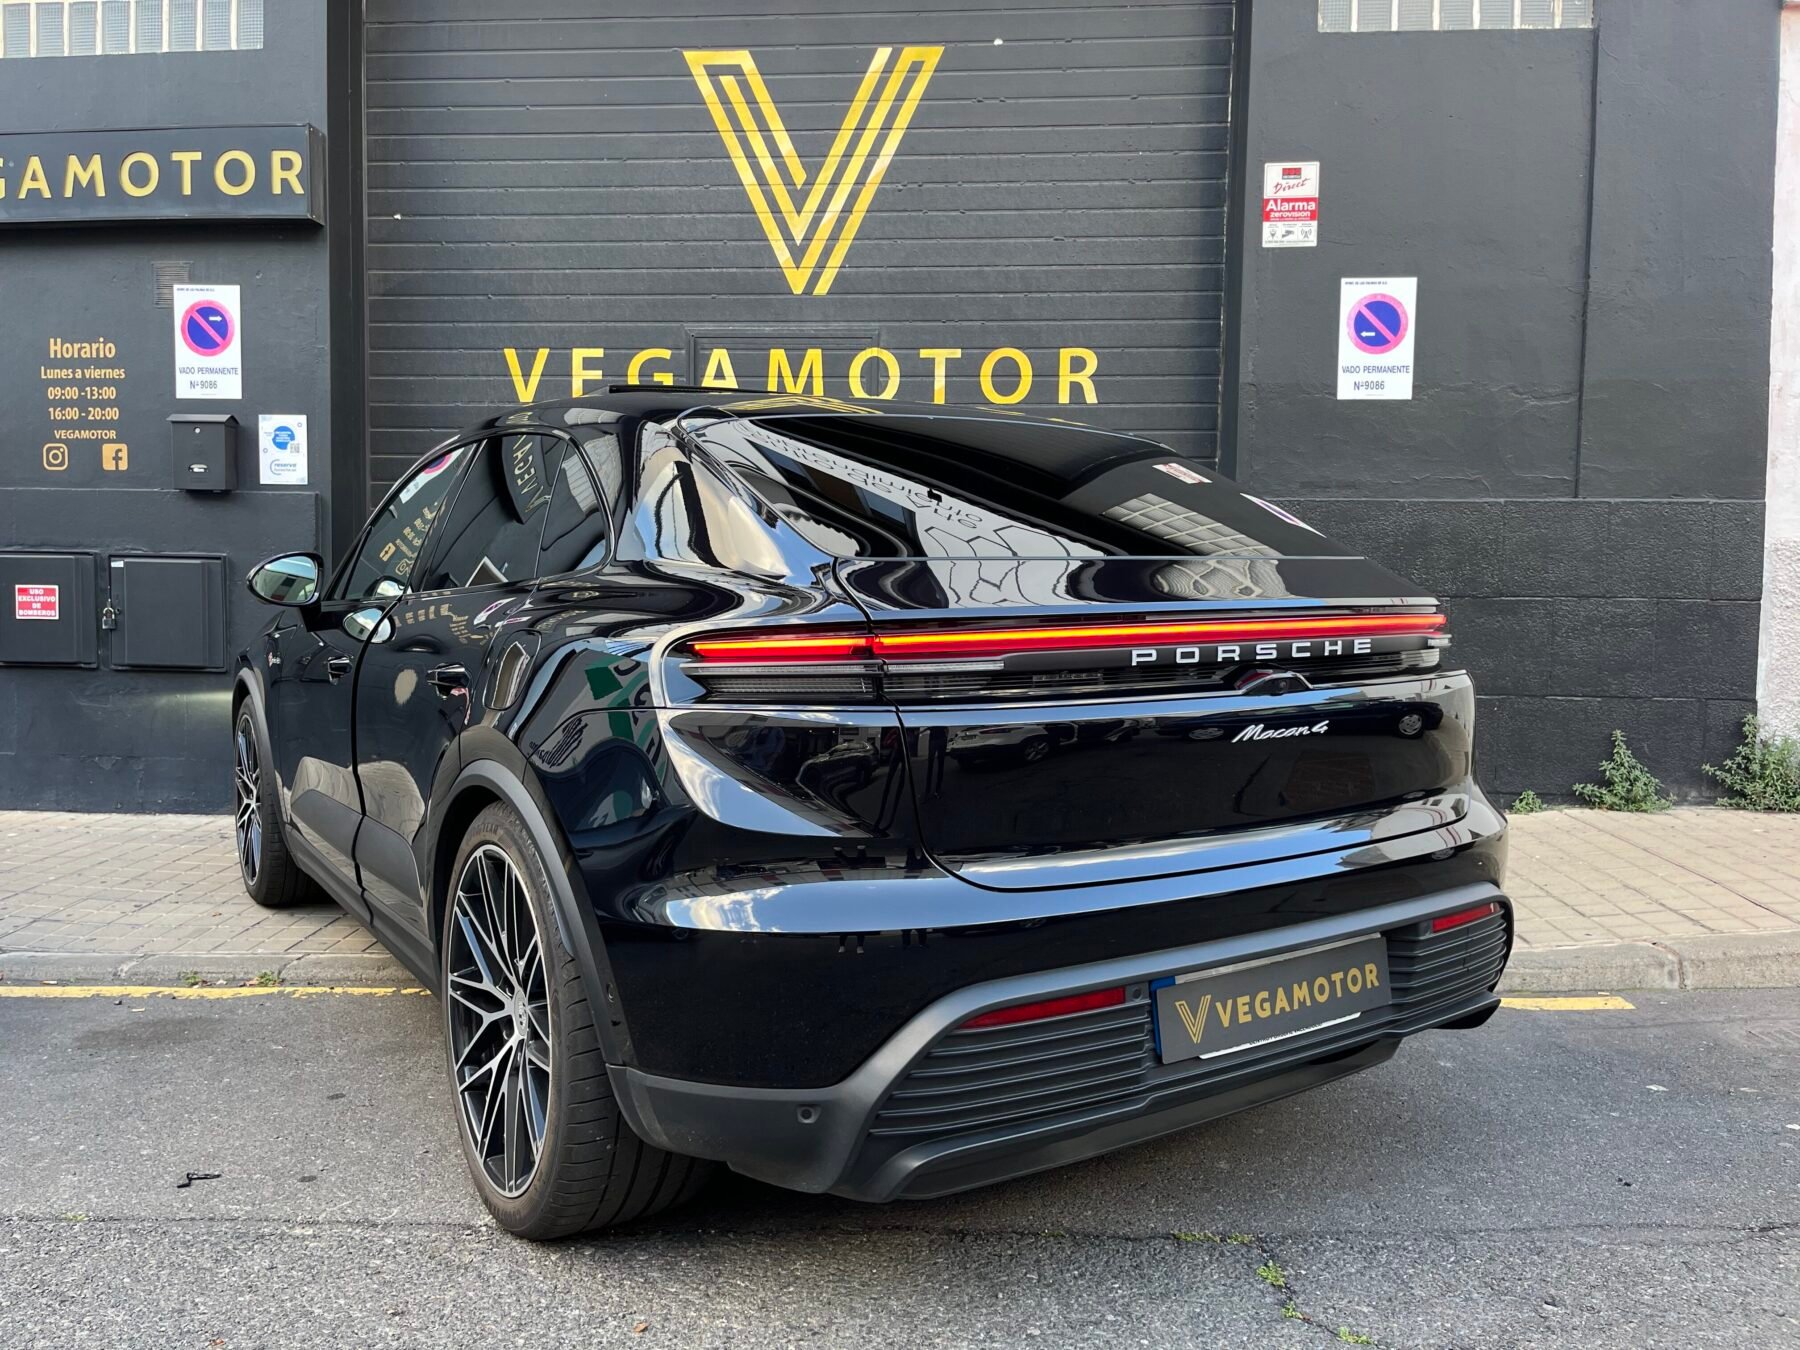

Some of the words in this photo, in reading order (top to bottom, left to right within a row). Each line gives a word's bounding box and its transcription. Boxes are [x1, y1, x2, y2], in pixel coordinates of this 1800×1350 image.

[0, 150, 305, 199] AMOTOR
[1265, 199, 1316, 212] Alarma
[49, 337, 116, 359] Horario
[41, 366, 73, 379] Lunes
[75, 369, 82, 379] a
[84, 366, 125, 379] viernes
[179, 367, 195, 375] VADO
[197, 367, 239, 375] PERMANENTE
[503, 347, 1099, 404] VEGAMOTOR
[1341, 365, 1361, 374] VADO
[1363, 365, 1410, 374] PERMANENTE
[48, 387, 79, 399] 09:00
[48, 408, 79, 420] 16:00
[88, 408, 119, 420] 20:00
[54, 430, 117, 439] VEGAMOTOR
[1131, 638, 1372, 666] PORSCHE
[1215, 962, 1380, 1028] VEGAMOTOR
